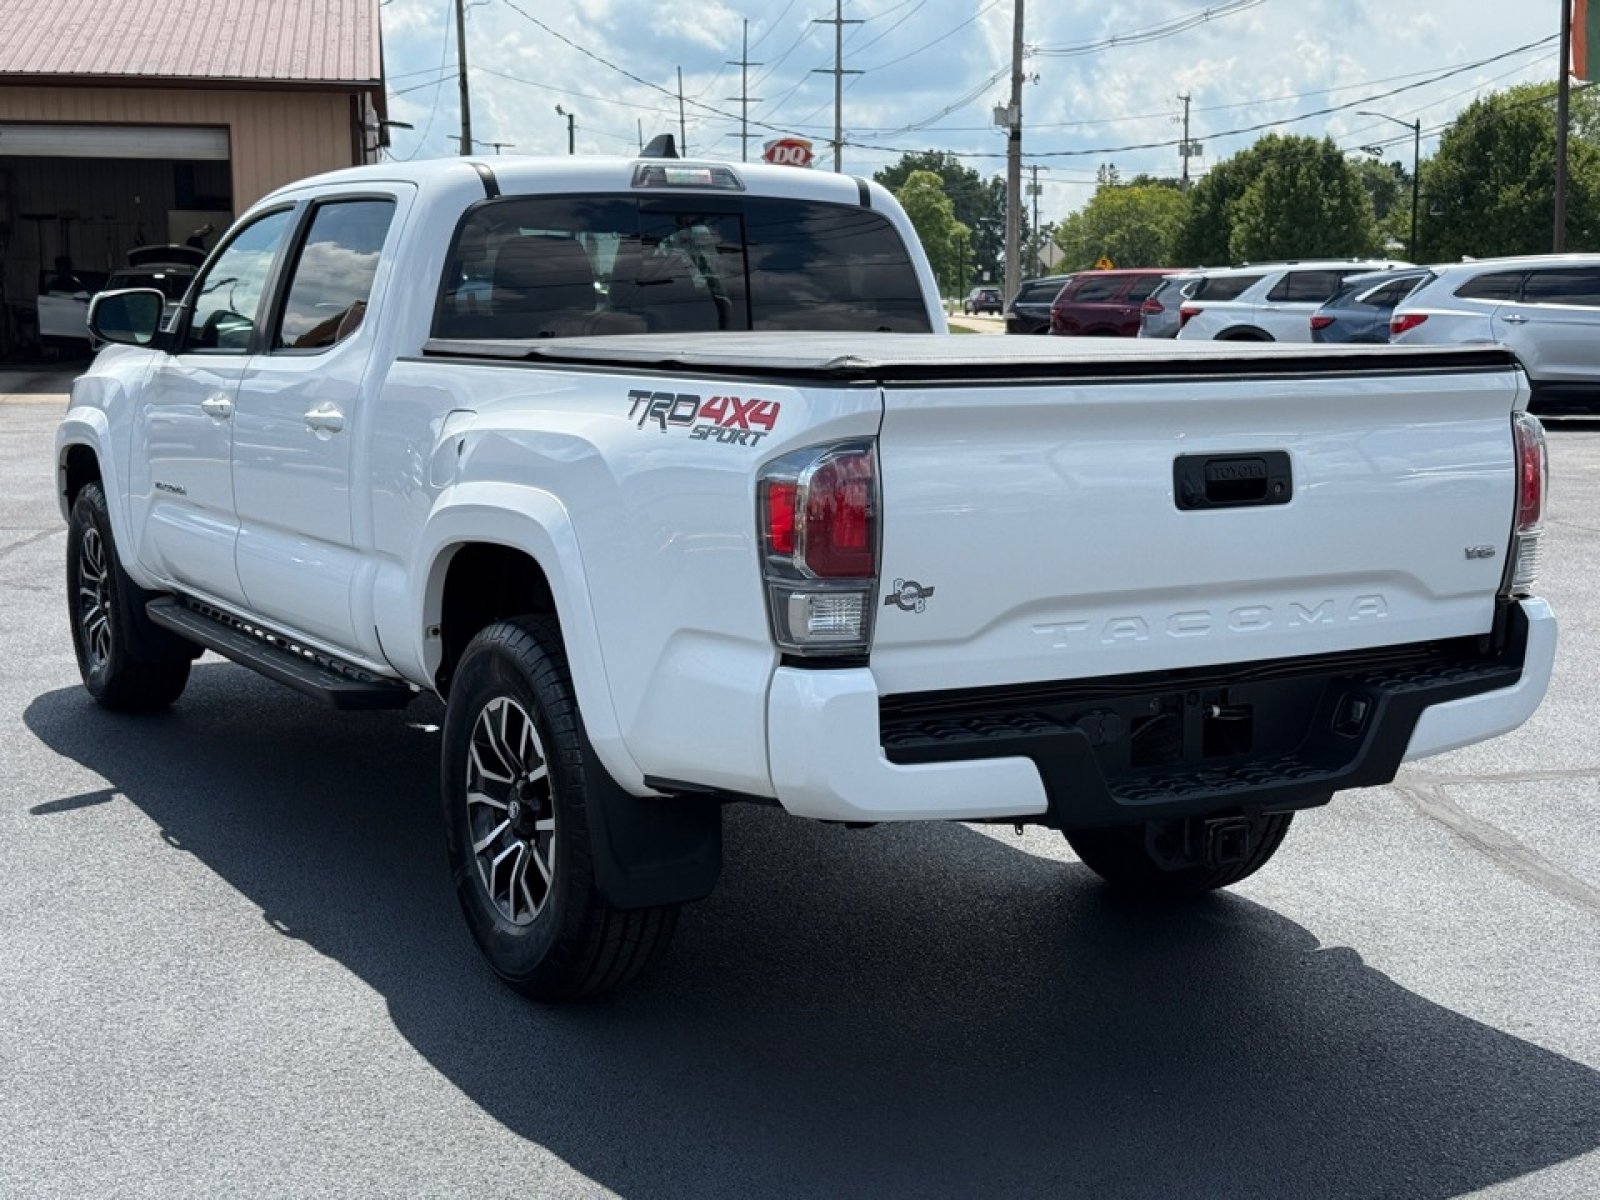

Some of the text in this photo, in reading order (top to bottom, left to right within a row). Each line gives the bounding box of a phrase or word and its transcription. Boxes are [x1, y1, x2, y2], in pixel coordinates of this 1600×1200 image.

[774, 146, 806, 166] DQ
[628, 389, 700, 432] TRD
[689, 425, 768, 448] SPORT
[1031, 594, 1388, 648] TACOMA
